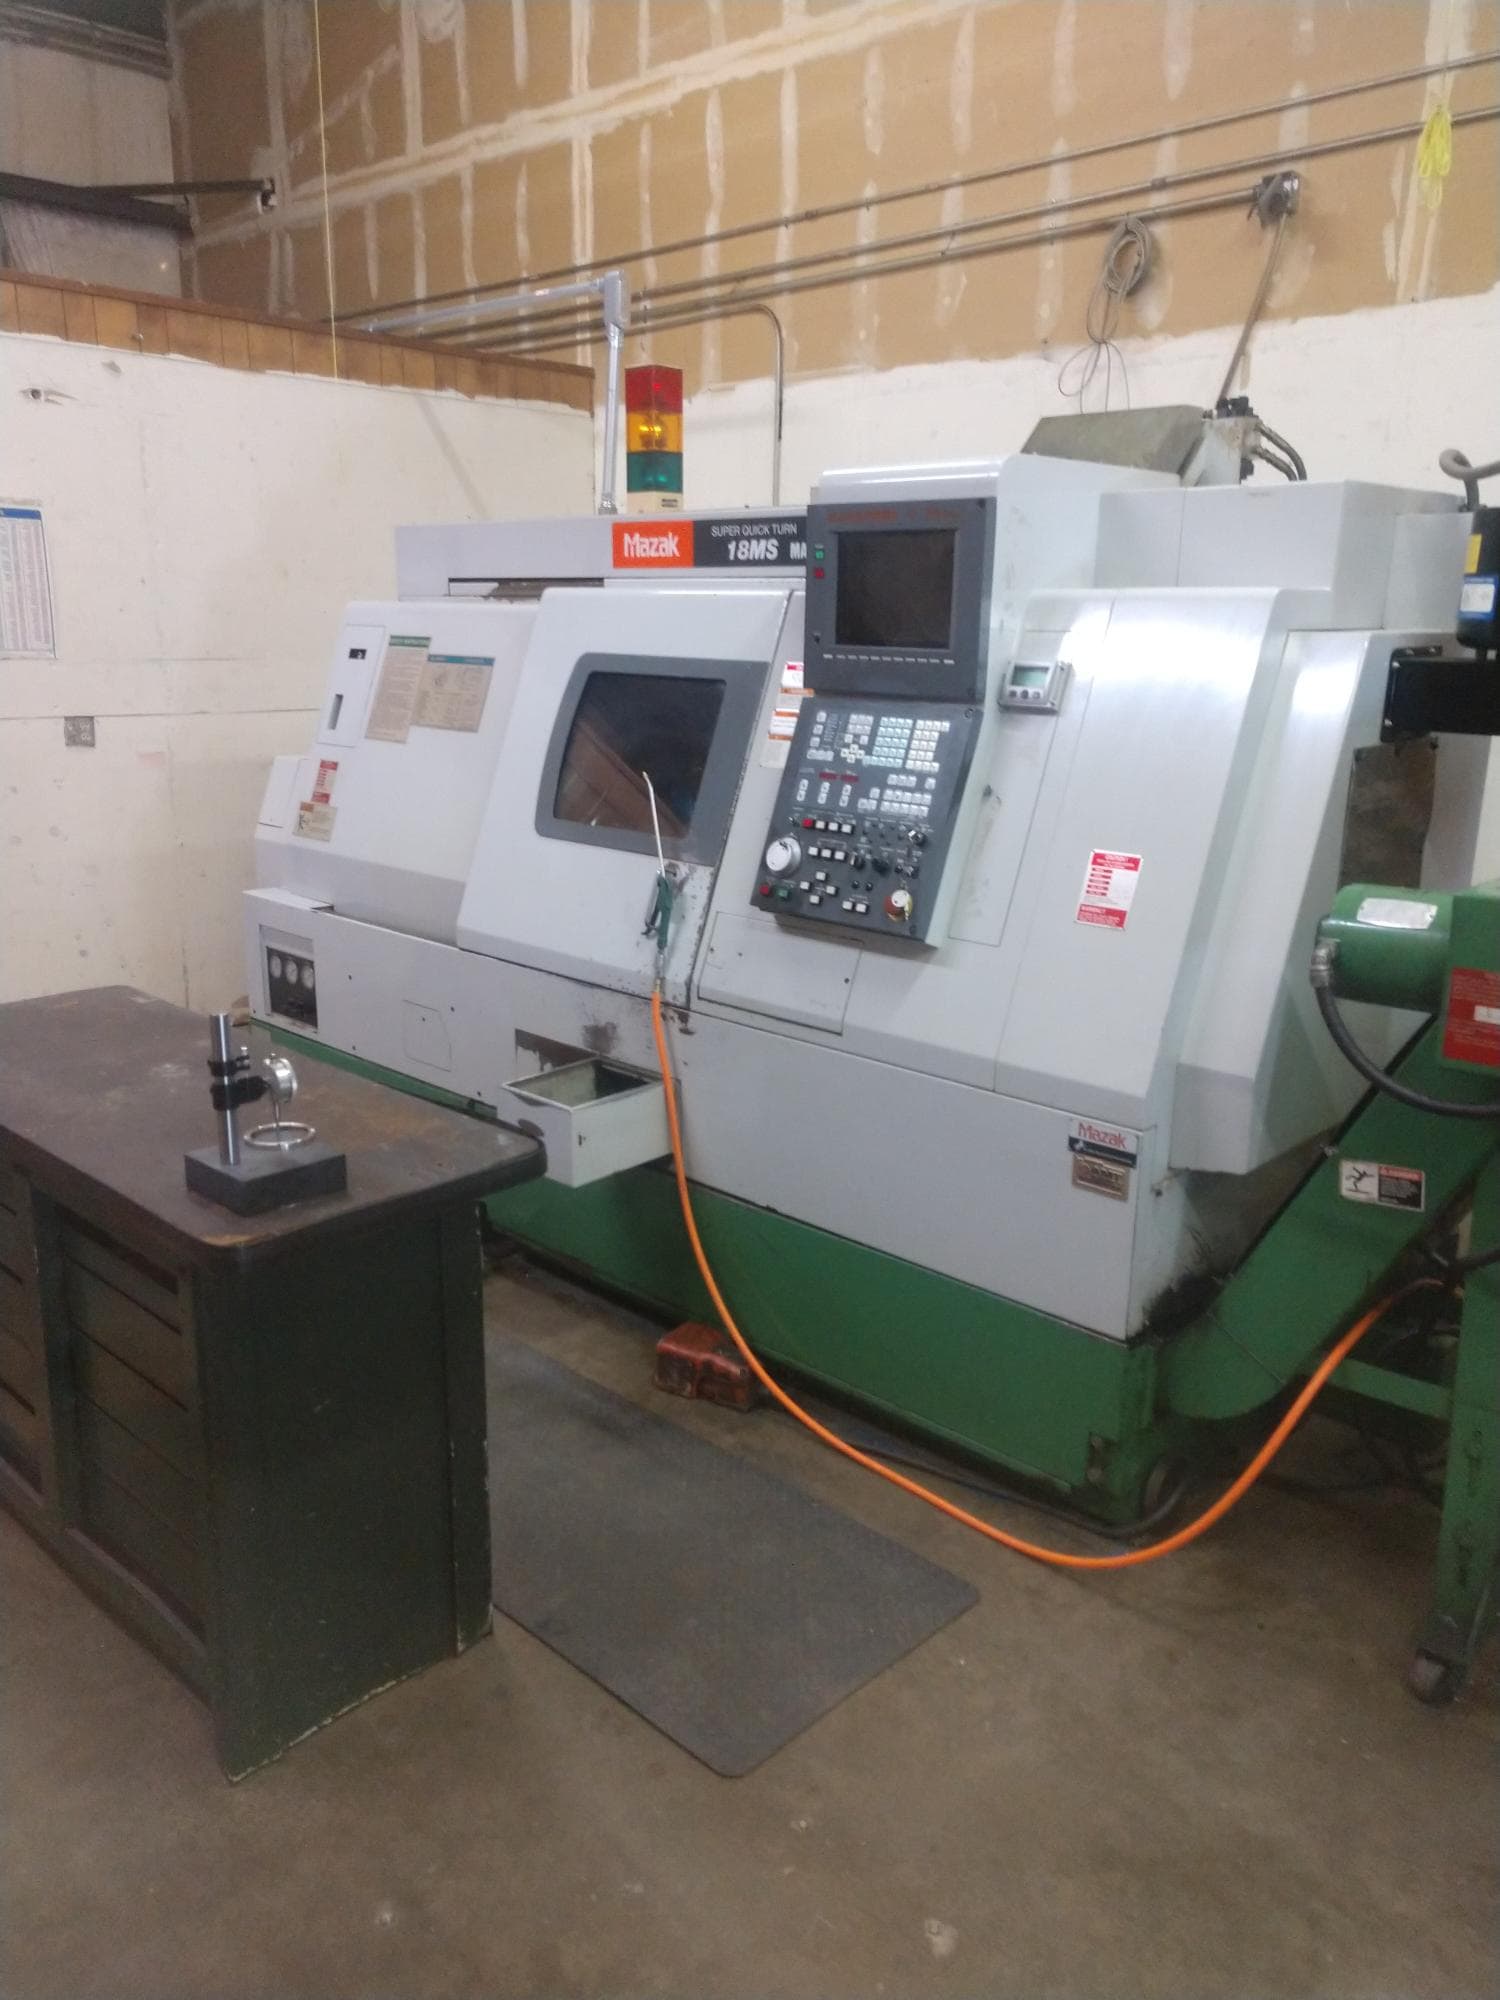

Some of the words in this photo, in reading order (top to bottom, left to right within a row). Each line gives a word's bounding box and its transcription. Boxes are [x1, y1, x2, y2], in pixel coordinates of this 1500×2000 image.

[711, 525, 740, 537] SUPER
[741, 523, 770, 537] QUICK
[772, 523, 798, 536] TURN
[623, 532, 681, 558] Mazak
[728, 538, 779, 561] 18MS
[1078, 1123, 1127, 1148] Mazak
